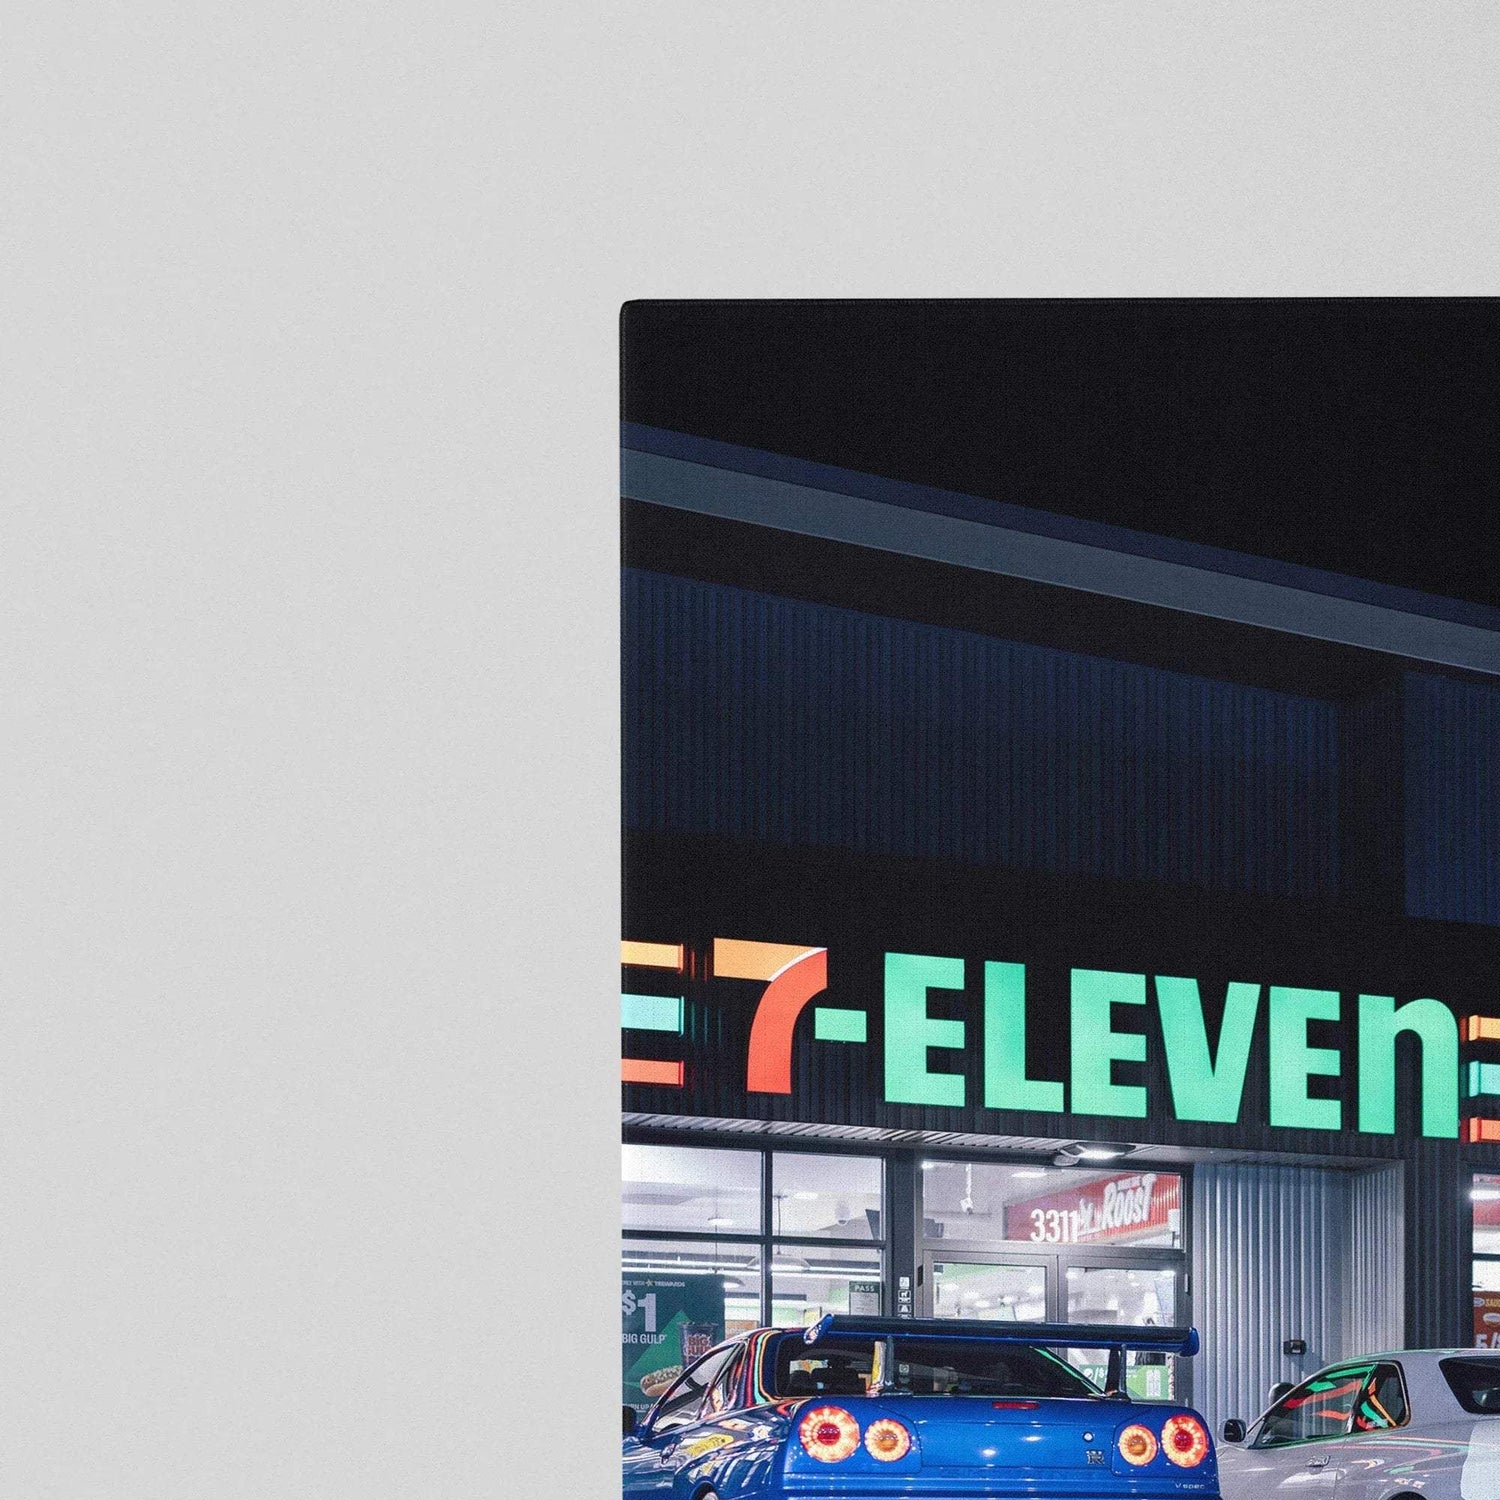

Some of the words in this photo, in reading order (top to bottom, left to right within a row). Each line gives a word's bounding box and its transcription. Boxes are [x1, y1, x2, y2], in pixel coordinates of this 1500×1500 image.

[1030, 1208, 1079, 1243] 3311
[855, 1284, 875, 1292] PASS
[622, 1289, 657, 1332] $1
[622, 1333, 638, 1344] BIG
[640, 1333, 666, 1345] GULP
